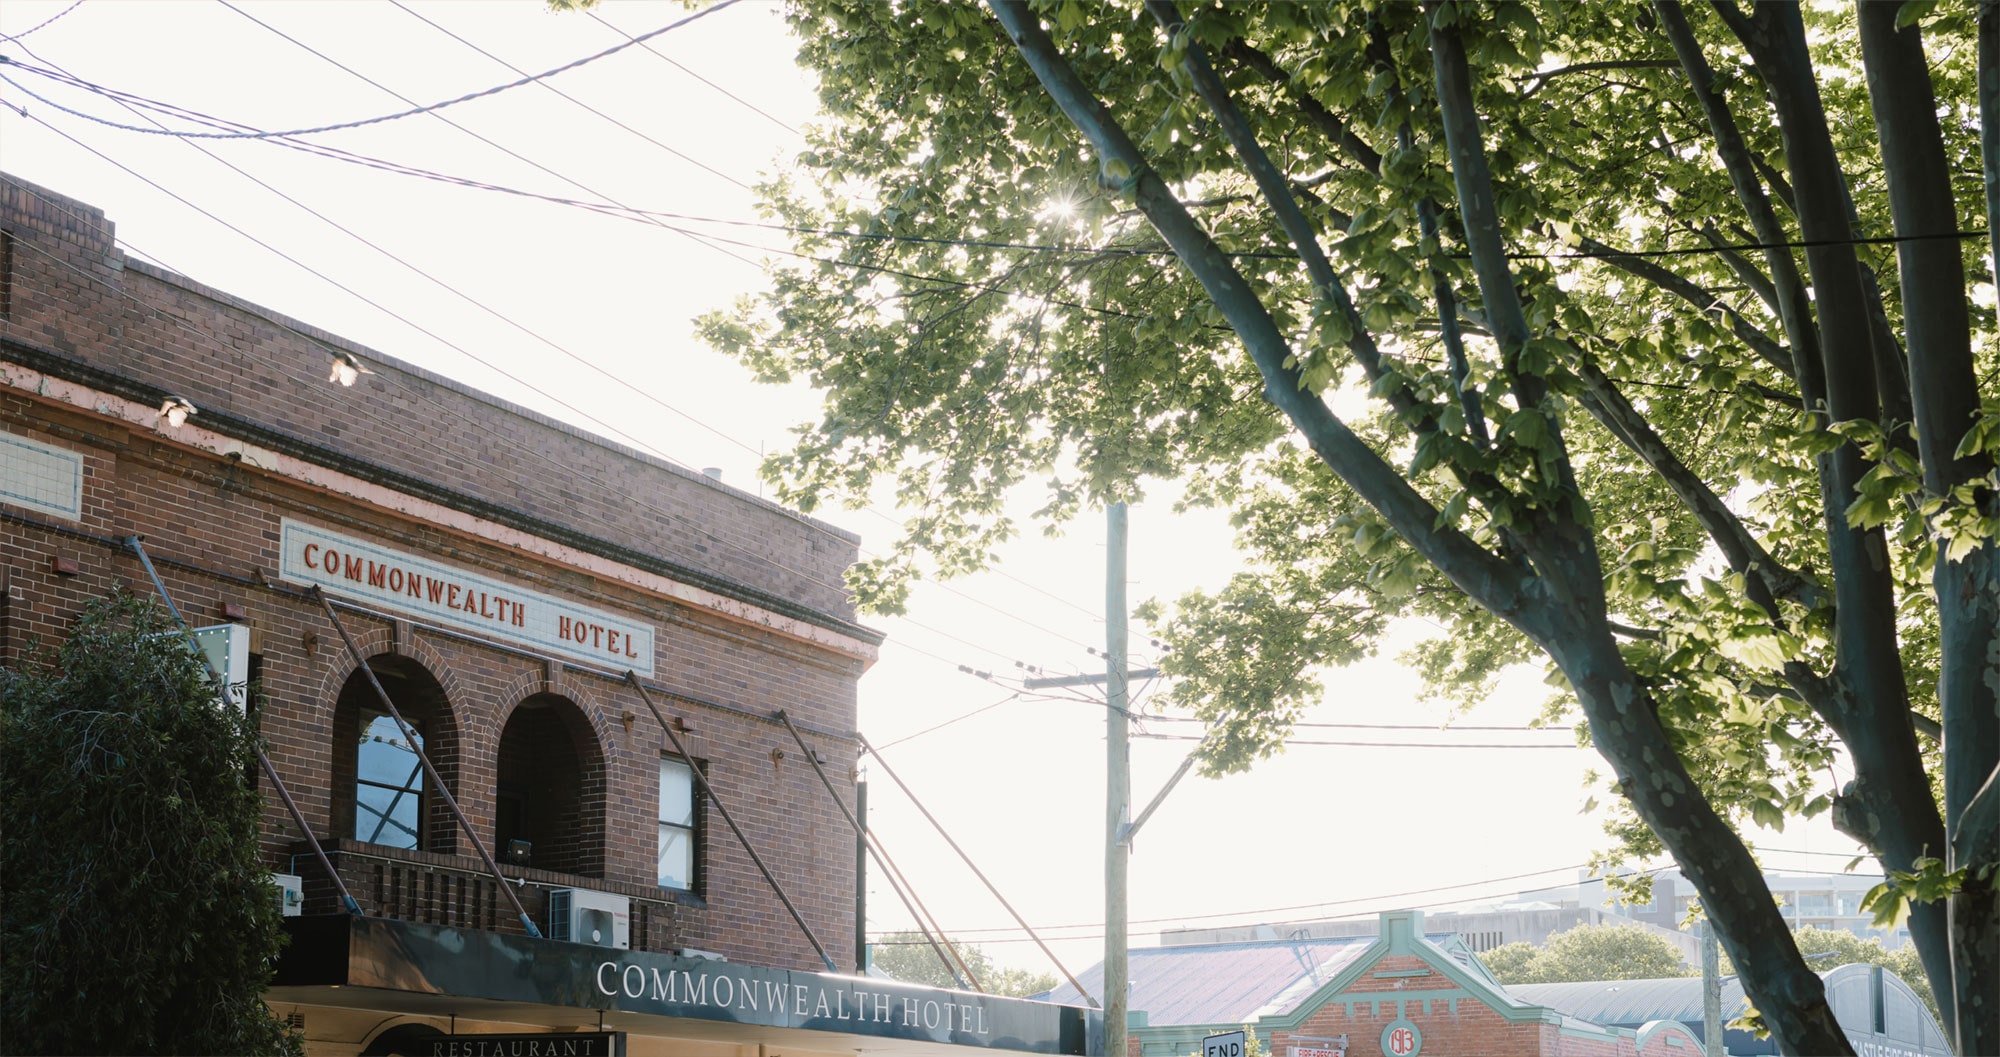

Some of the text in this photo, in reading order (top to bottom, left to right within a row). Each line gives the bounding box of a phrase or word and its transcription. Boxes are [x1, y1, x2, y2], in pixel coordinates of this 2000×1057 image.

[304, 543, 638, 658] COMMONWEALTH HOTEL
[597, 961, 989, 1034] COMMONWEALTH HOTEL
[433, 1040, 594, 1057] RESTAURANT
[1208, 1043, 1239, 1057] END
[1391, 1029, 1415, 1054] 1913
